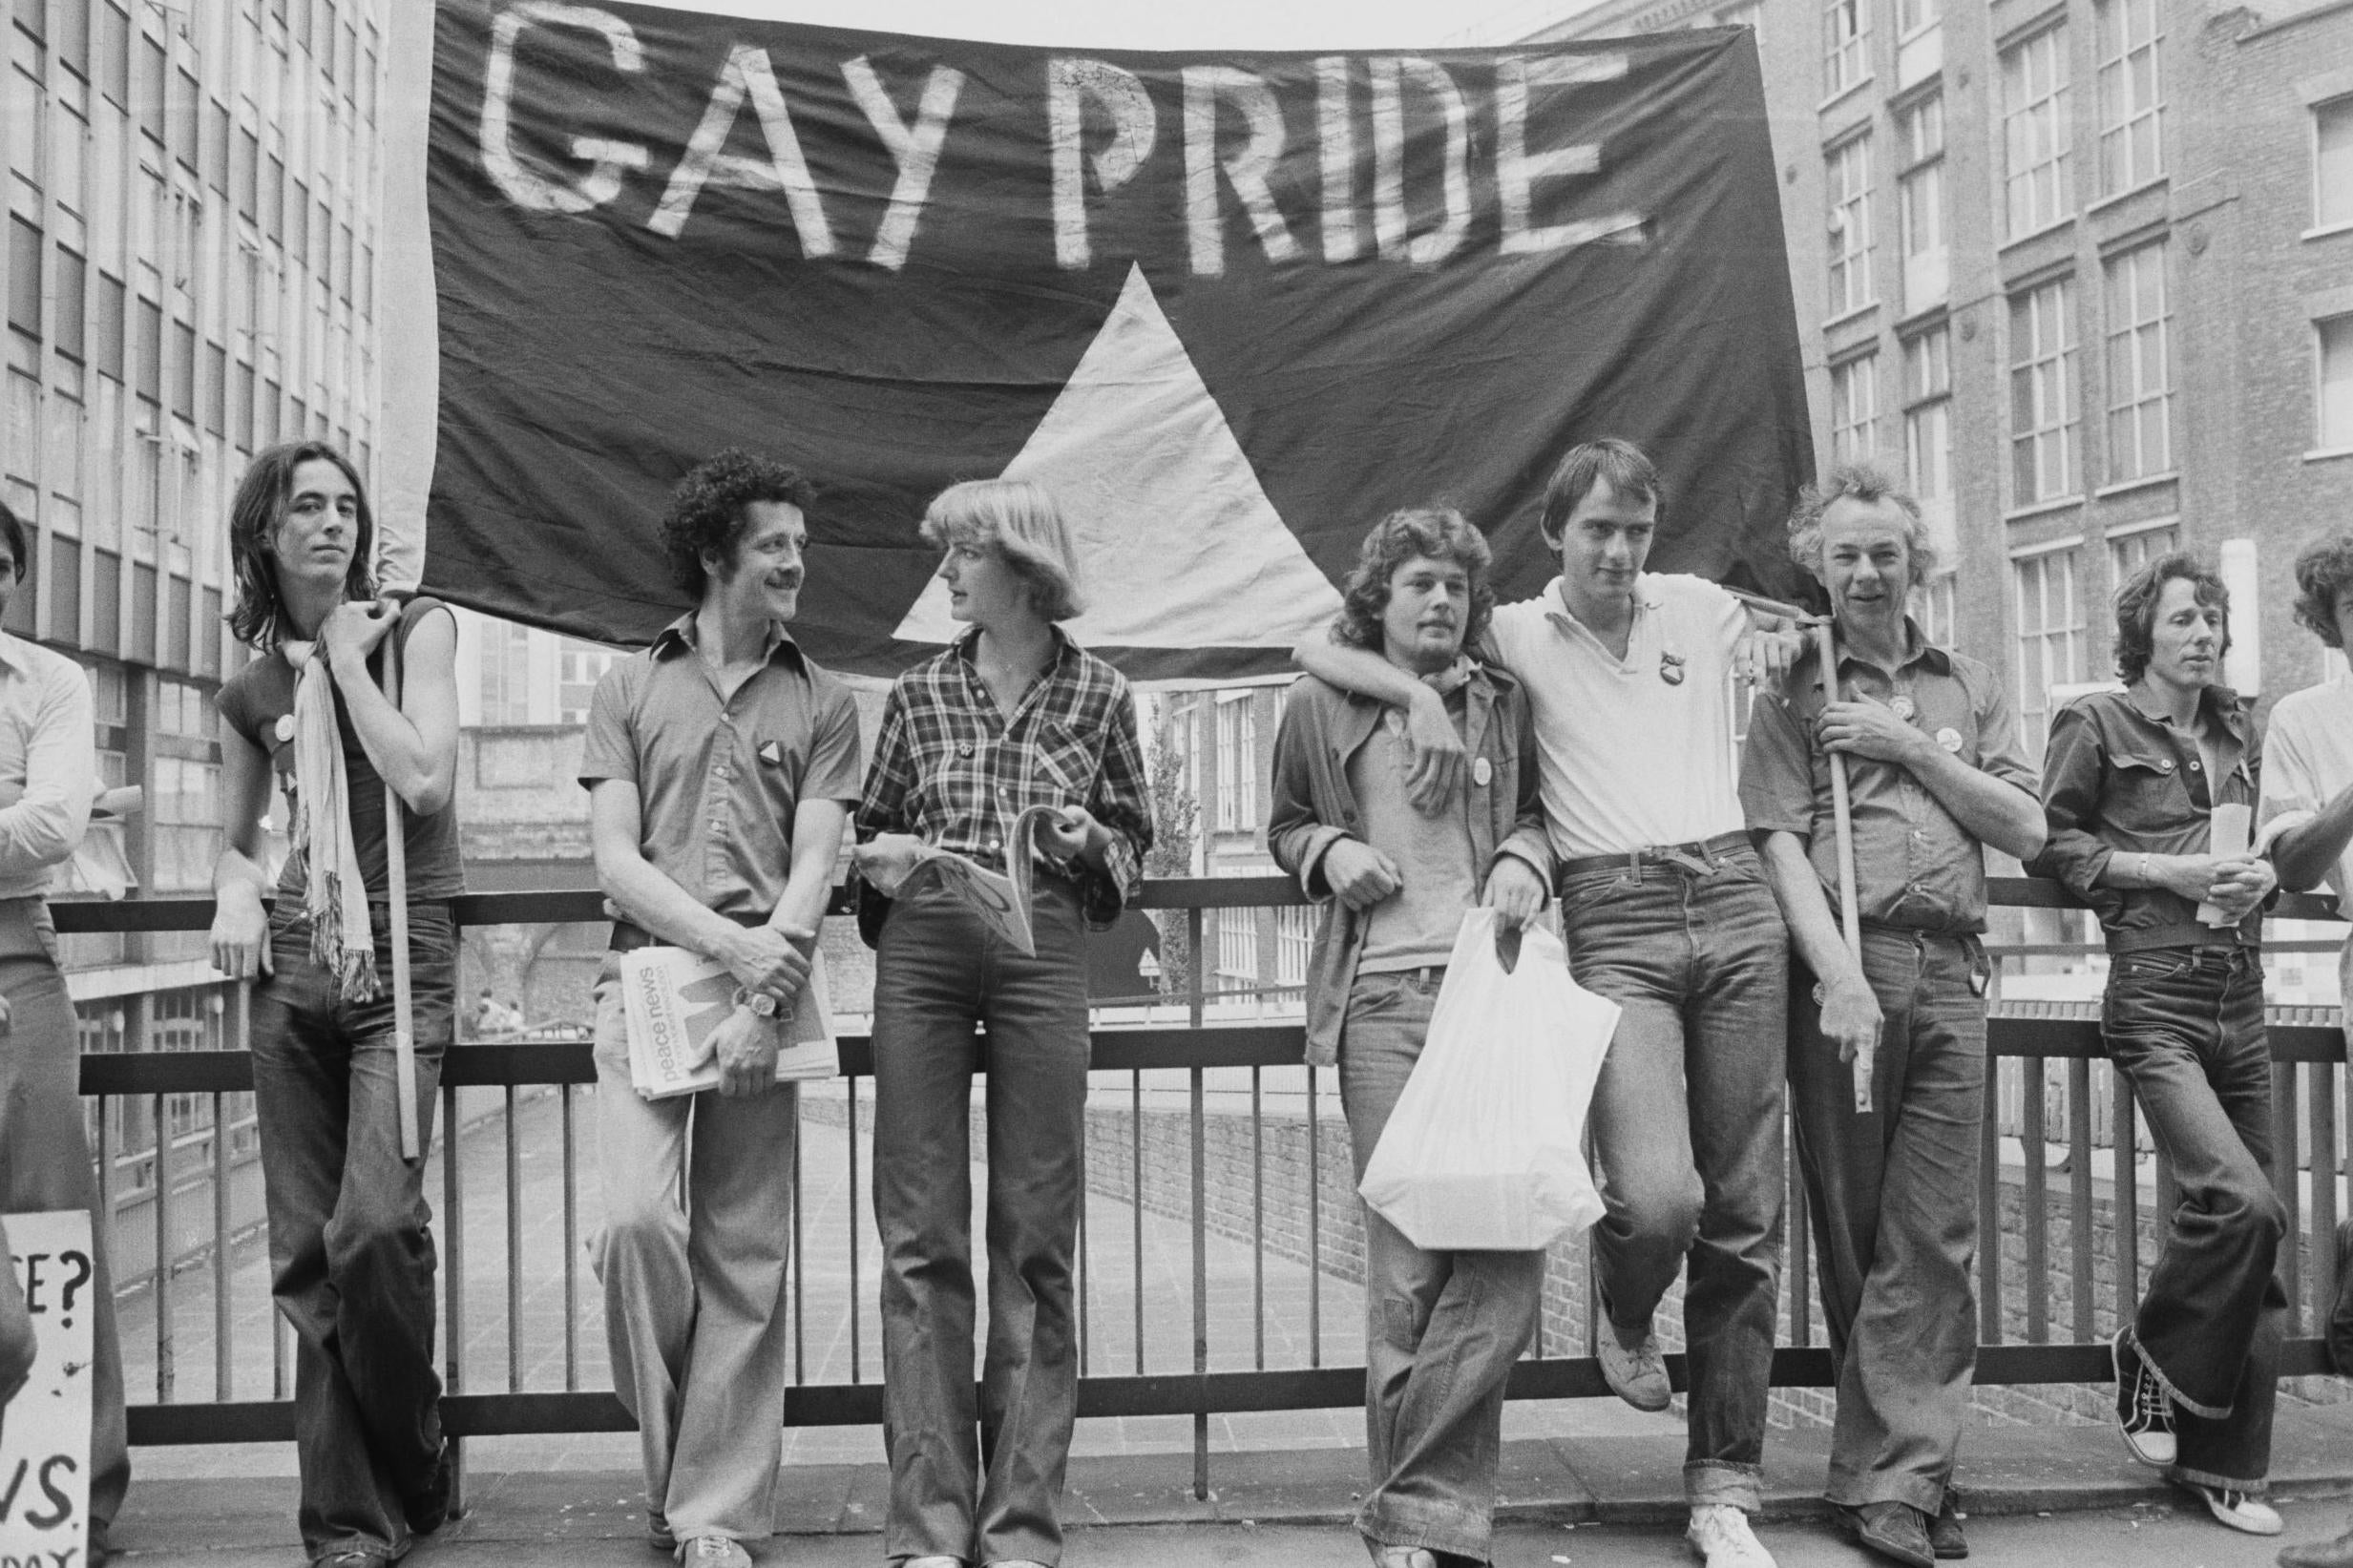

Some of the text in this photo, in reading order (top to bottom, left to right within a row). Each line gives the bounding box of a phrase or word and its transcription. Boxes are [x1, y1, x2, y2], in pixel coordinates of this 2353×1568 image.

[479, 3, 1646, 275] GAY PRIDE
[640, 966, 663, 1018] news
[652, 1021, 682, 1082] peace
[10, 1249, 92, 1330] E?
